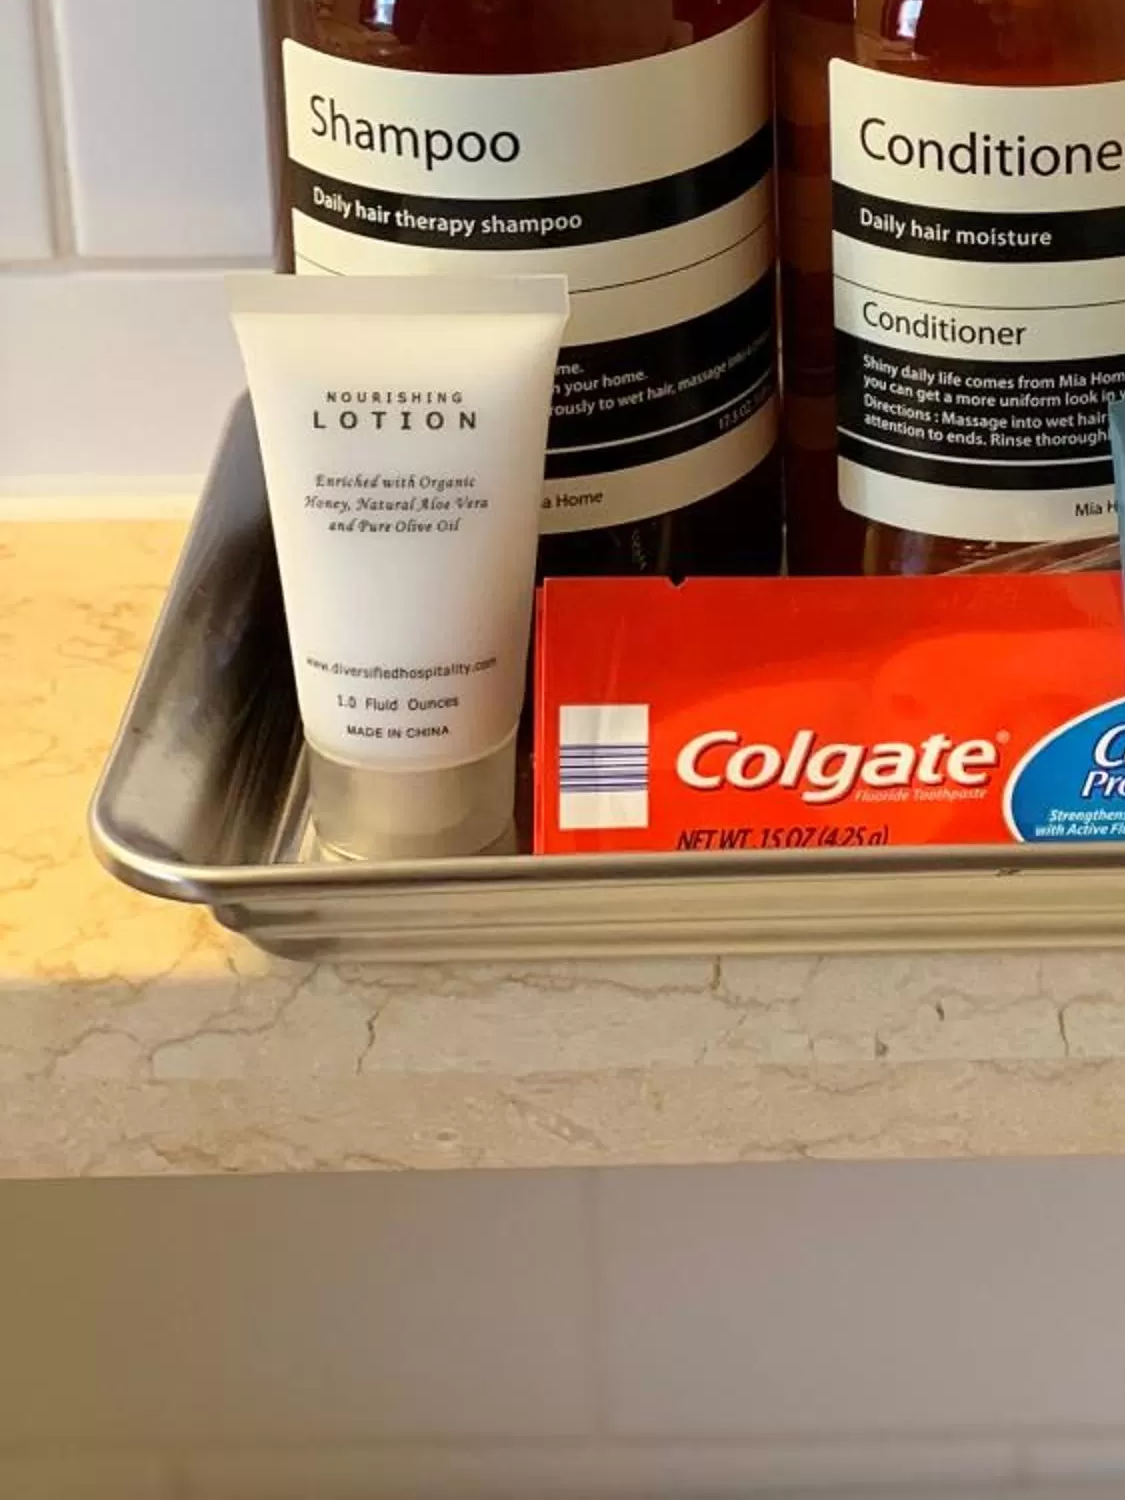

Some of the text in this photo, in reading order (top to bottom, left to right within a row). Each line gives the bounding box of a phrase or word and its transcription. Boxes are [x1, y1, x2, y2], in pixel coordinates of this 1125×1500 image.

[310, 94, 520, 171] Shampoo
[313, 186, 582, 237] Daily hair therapy shampoo
[859, 206, 1053, 248] Daily hair moisture
[862, 300, 1027, 347] Conditioner
[863, 353, 898, 378] Shiny
[901, 364, 936, 386] daily
[938, 371, 962, 387] life
[965, 377, 1014, 390] comes
[1018, 375, 1055, 389] from
[1059, 374, 1087, 388] Mia
[563, 379, 600, 398] your
[601, 369, 649, 389] home.
[599, 397, 616, 411] to
[617, 392, 644, 407] wet
[677, 361, 727, 392] massage
[863, 375, 887, 391] you
[890, 381, 913, 396] can
[916, 387, 941, 404] get
[943, 393, 951, 403] a
[955, 393, 997, 408] more
[1000, 391, 1062, 408] uniform
[1065, 388, 1098, 406] look
[1101, 389, 1116, 402] in
[326, 391, 463, 405] NOURISHING
[313, 410, 478, 430] LOTION
[863, 393, 932, 422] Directions
[941, 412, 1008, 431] Massage
[1011, 414, 1043, 429] into
[1045, 412, 1074, 428] wet
[1077, 410, 1107, 426] hair
[863, 413, 925, 439] attention
[928, 427, 943, 441] to
[946, 428, 987, 447] ends.
[990, 432, 1032, 448] Rinse
[315, 473, 477, 492] Enriched with Organic
[304, 495, 489, 514] Honey, Natural Aloe Vera
[556, 491, 604, 508] Home
[1075, 501, 1103, 517] Mia
[328, 518, 462, 532] and Pure Olive Oil
[306, 656, 497, 681] www.diversifiedhospitality.com
[337, 694, 459, 711] 1.0 Fluid Ounces
[346, 724, 449, 739] MADE IN CHINA
[675, 729, 998, 805] Colgate
[855, 786, 986, 801] Fluoride Toothpaste
[677, 828, 718, 850] NET
[1035, 824, 1064, 837] with
[1066, 823, 1108, 837] Active
